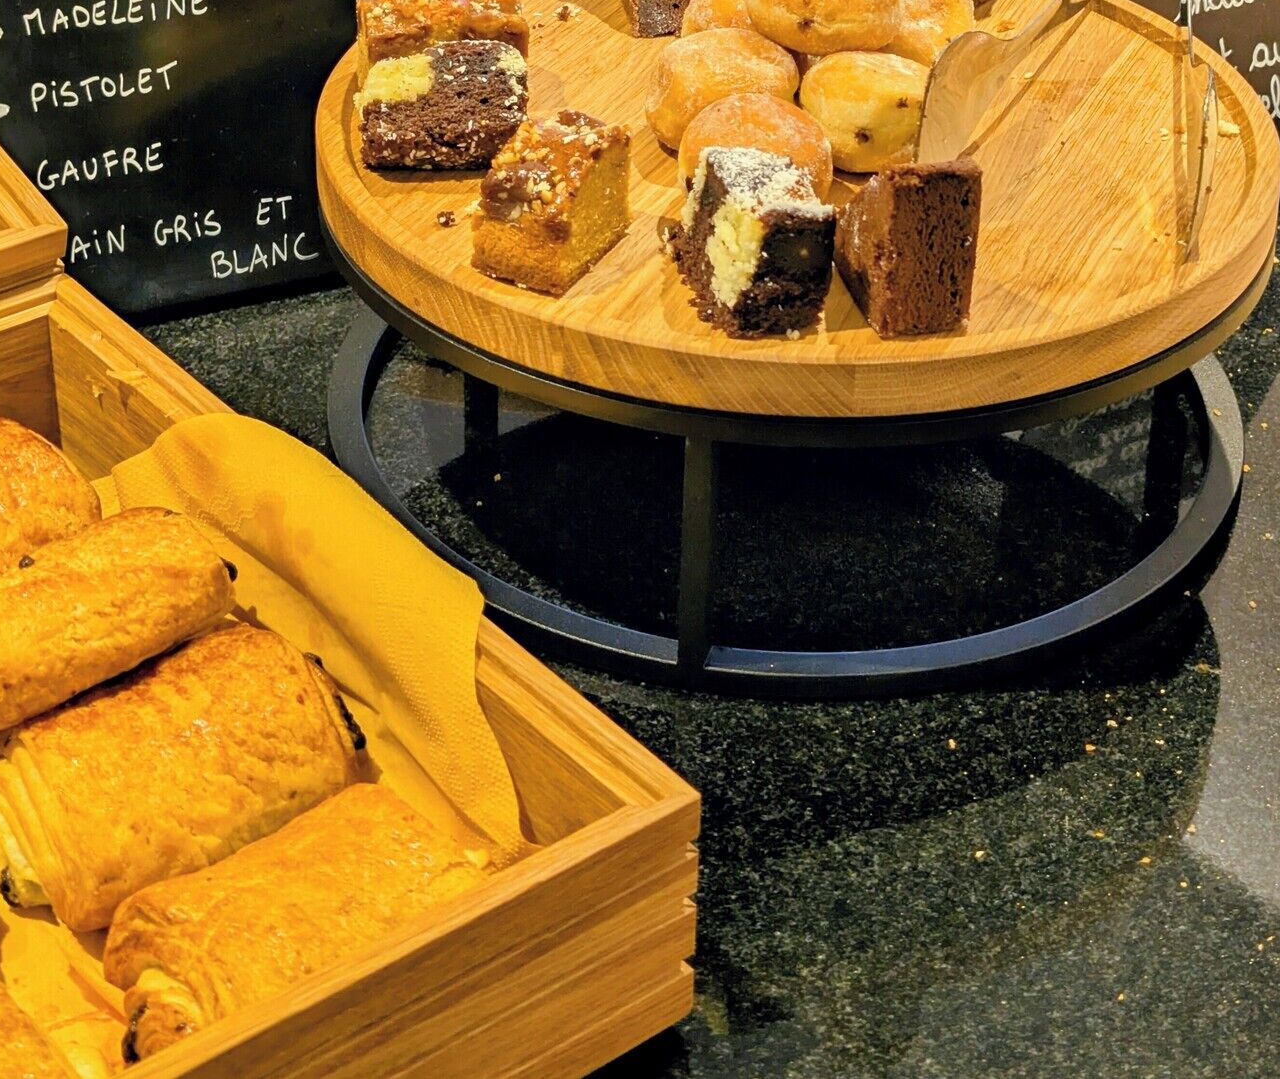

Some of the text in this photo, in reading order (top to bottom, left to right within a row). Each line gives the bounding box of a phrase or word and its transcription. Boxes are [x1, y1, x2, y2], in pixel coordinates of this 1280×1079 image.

[36, 142, 164, 191] GAUFRE
[70, 224, 126, 264] AIN
[255, 195, 294, 226] ET
[210, 232, 319, 279] BLANC
